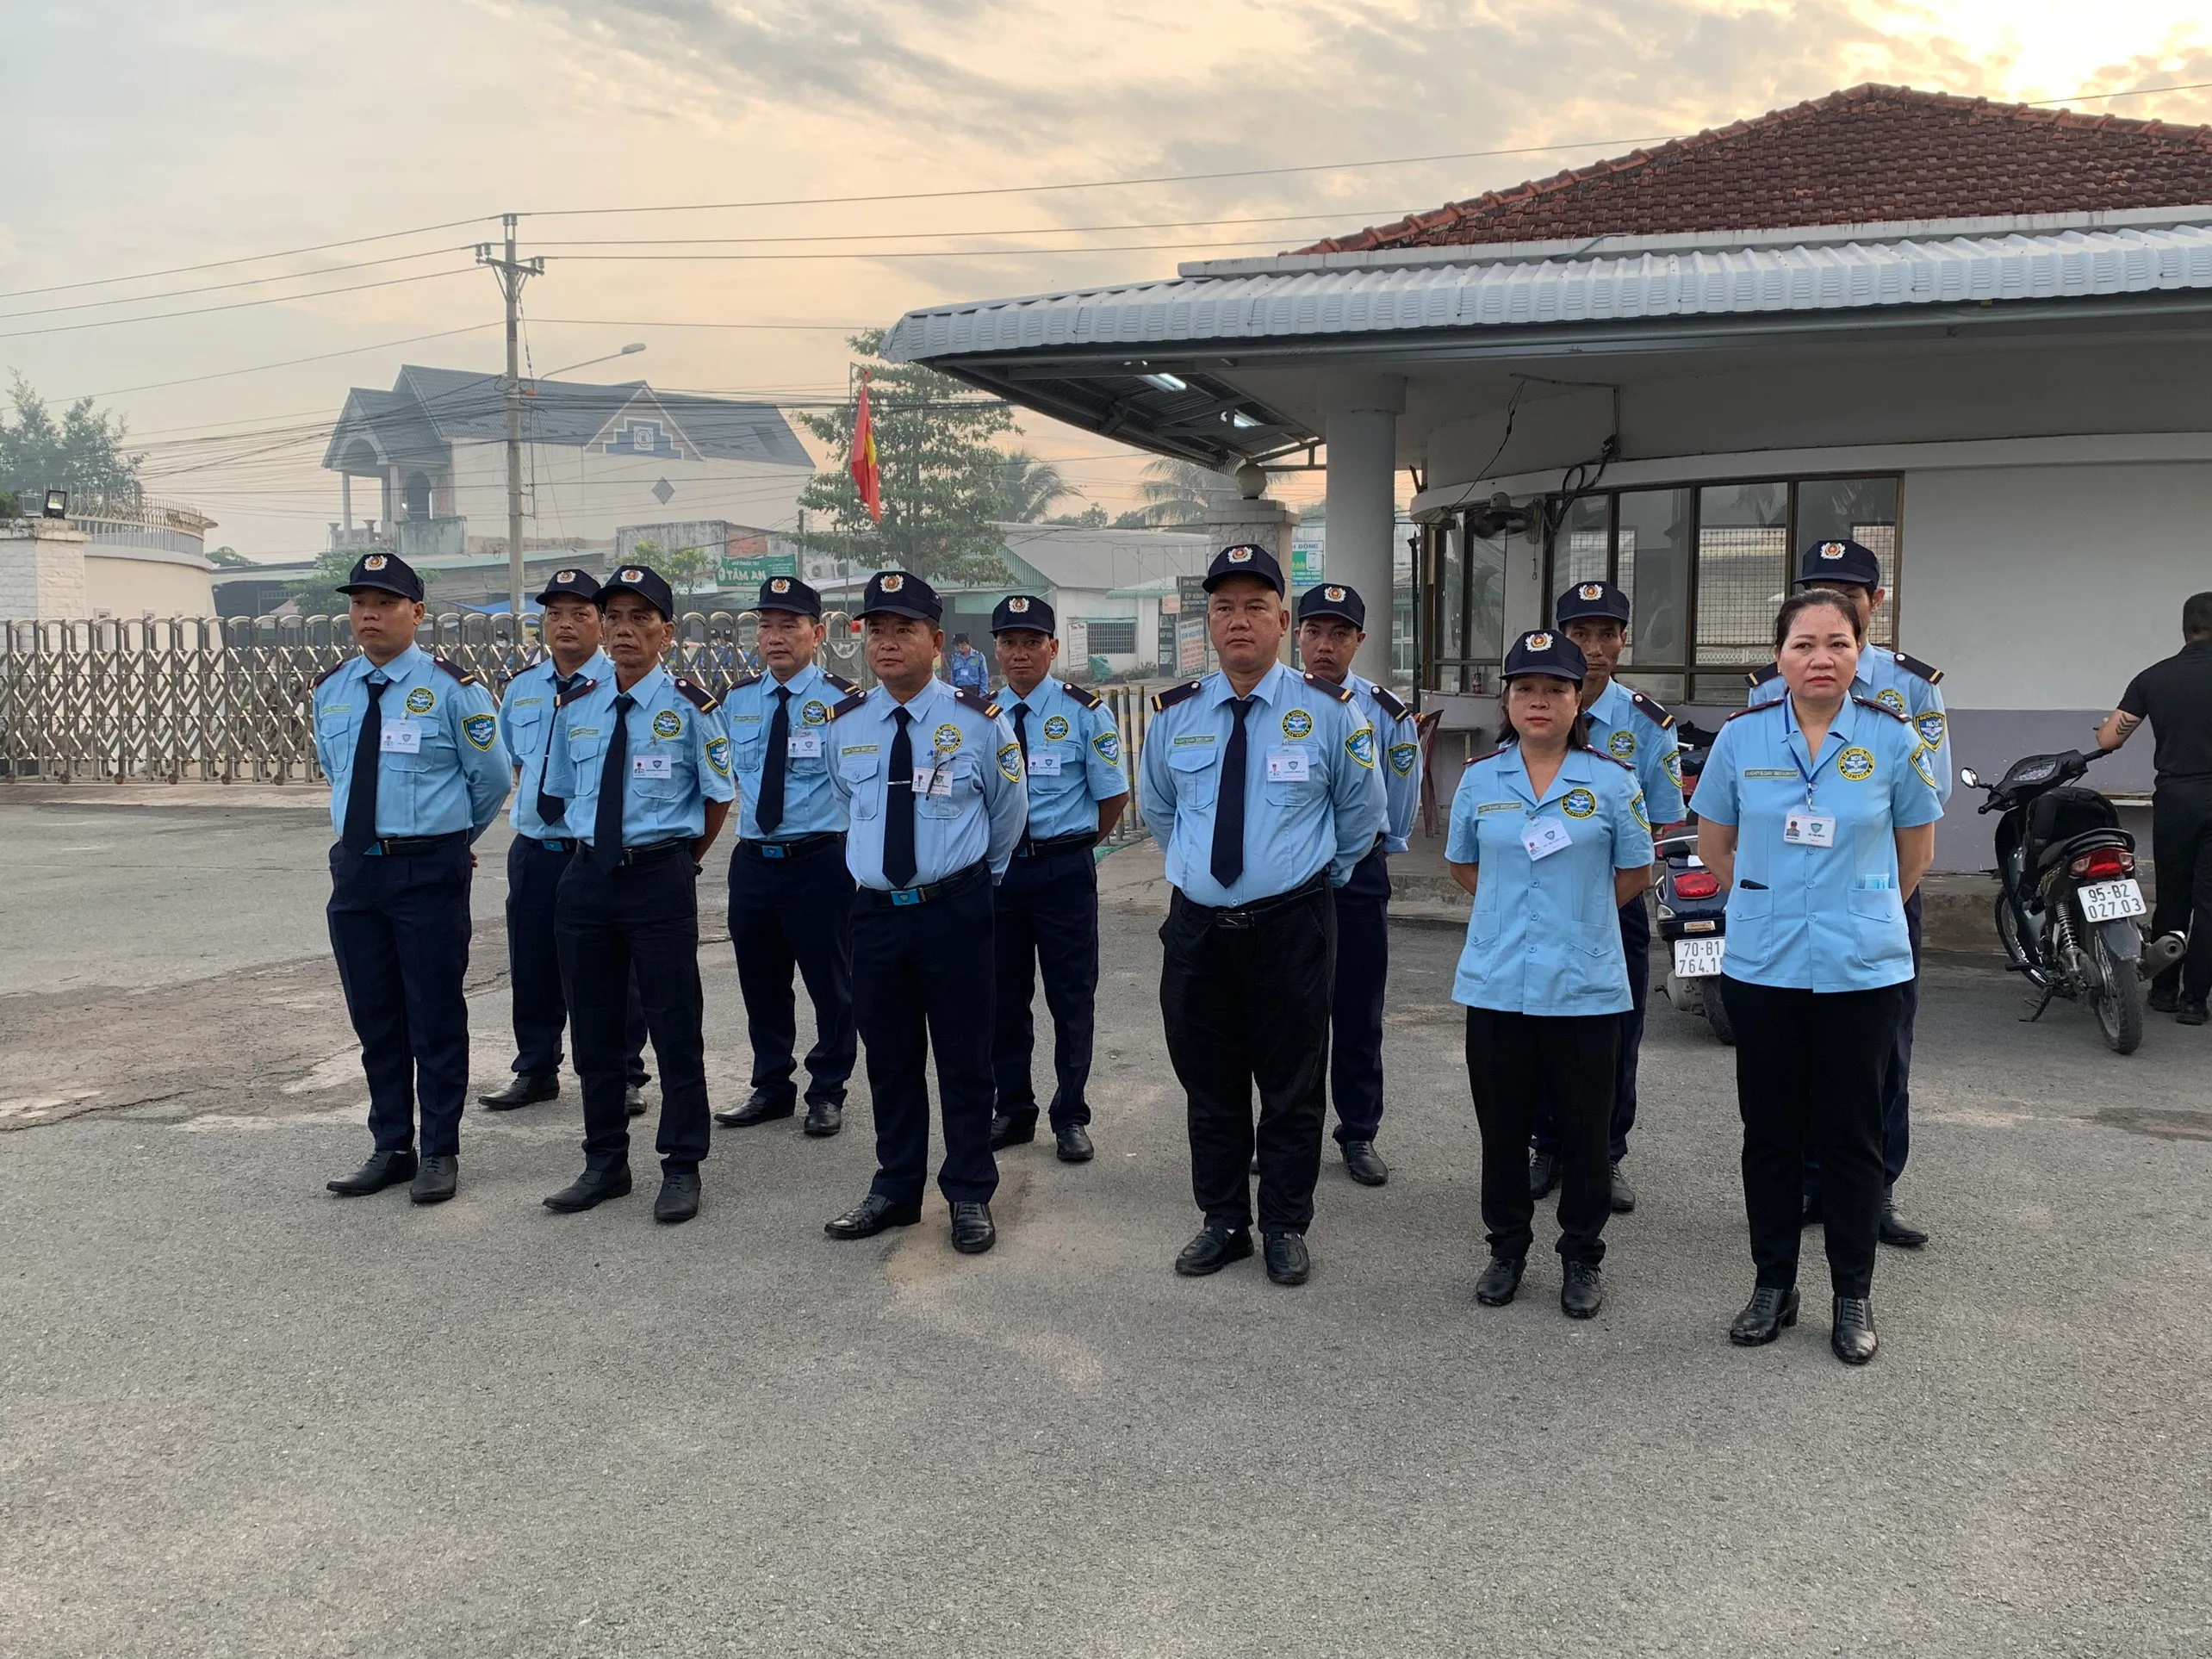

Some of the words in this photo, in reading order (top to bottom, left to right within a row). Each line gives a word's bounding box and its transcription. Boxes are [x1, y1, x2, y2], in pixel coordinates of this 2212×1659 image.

[726, 568, 749, 581] TÂM
[751, 569, 767, 581] AN
[2088, 884, 2130, 903] 95-B2
[2088, 898, 2141, 919] 027.03
[1684, 941, 1720, 958] 70-B1
